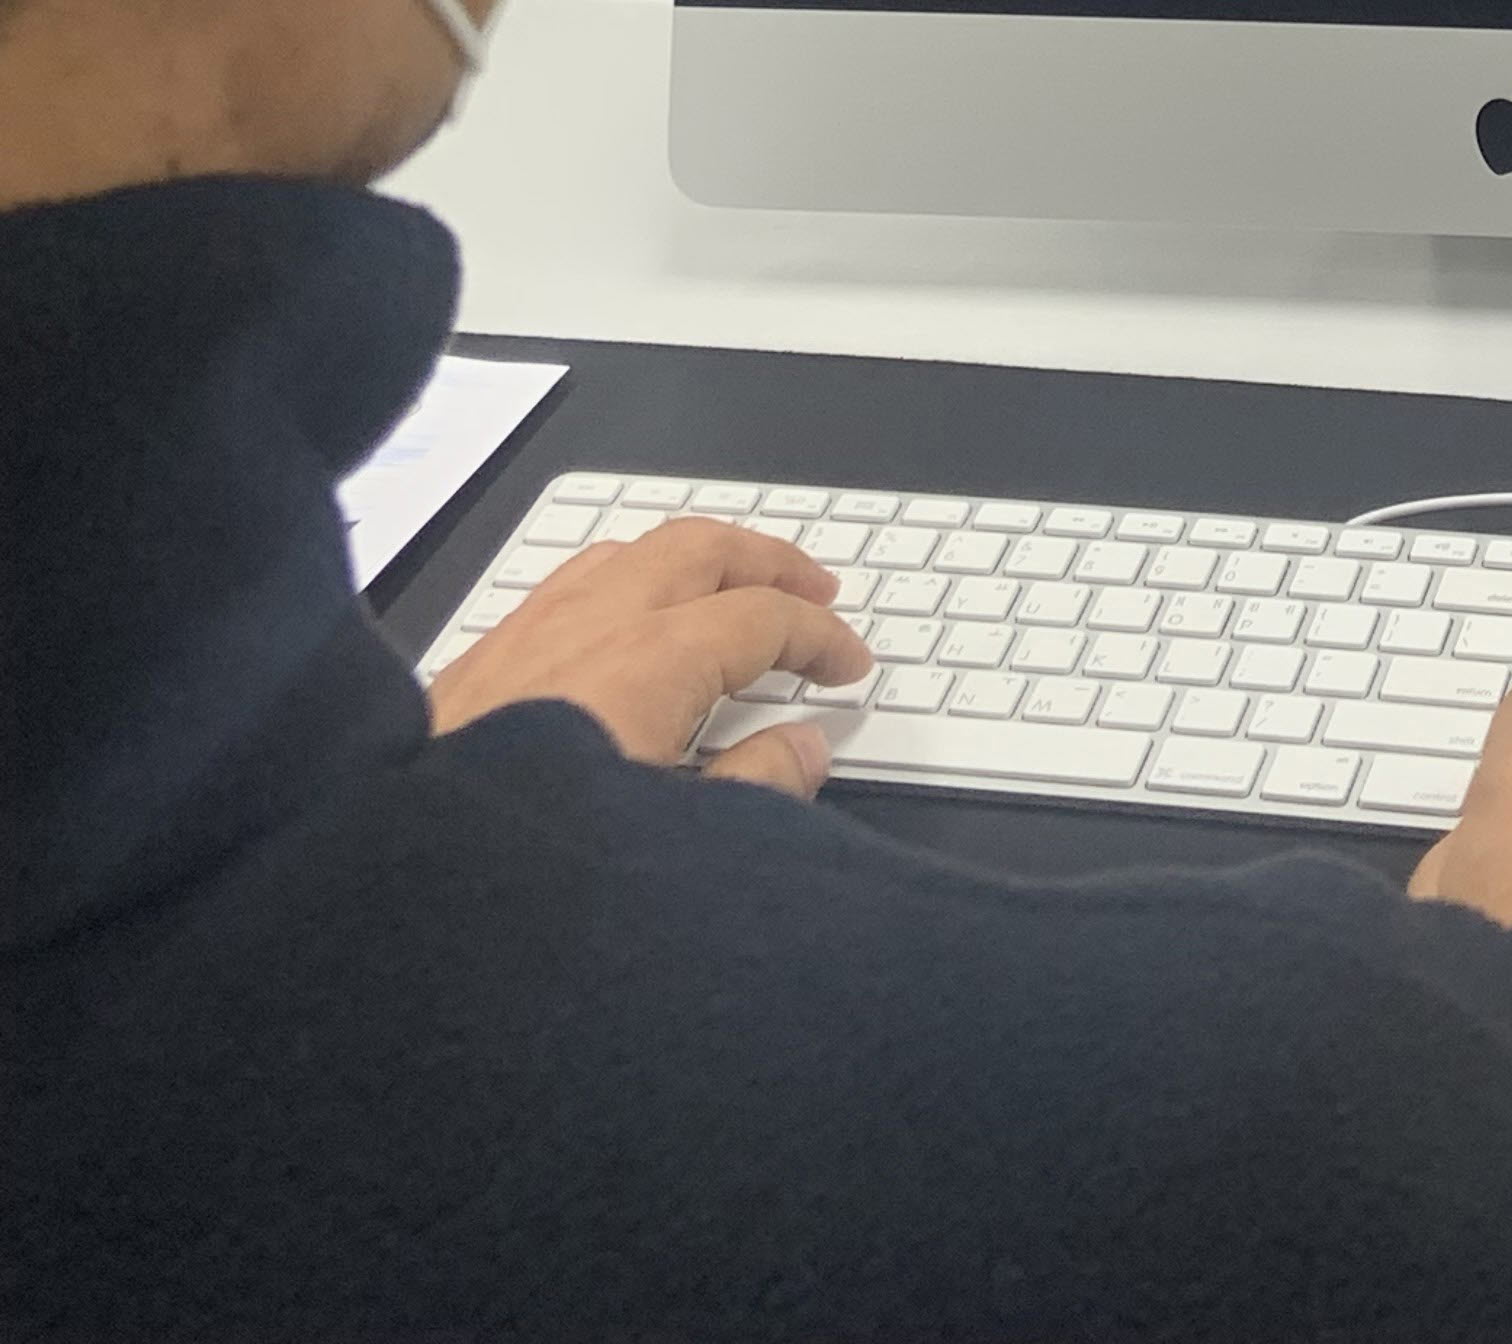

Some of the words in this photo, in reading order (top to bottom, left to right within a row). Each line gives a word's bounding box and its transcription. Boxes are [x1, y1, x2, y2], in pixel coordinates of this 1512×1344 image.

[1025, 602, 1041, 615] U
[1167, 613, 1184, 626] O
[1239, 619, 1254, 632] P
[947, 644, 964, 656] H
[1091, 653, 1107, 667] K
[886, 687, 900, 701] B
[957, 693, 977, 706] N
[1031, 699, 1052, 712] M
